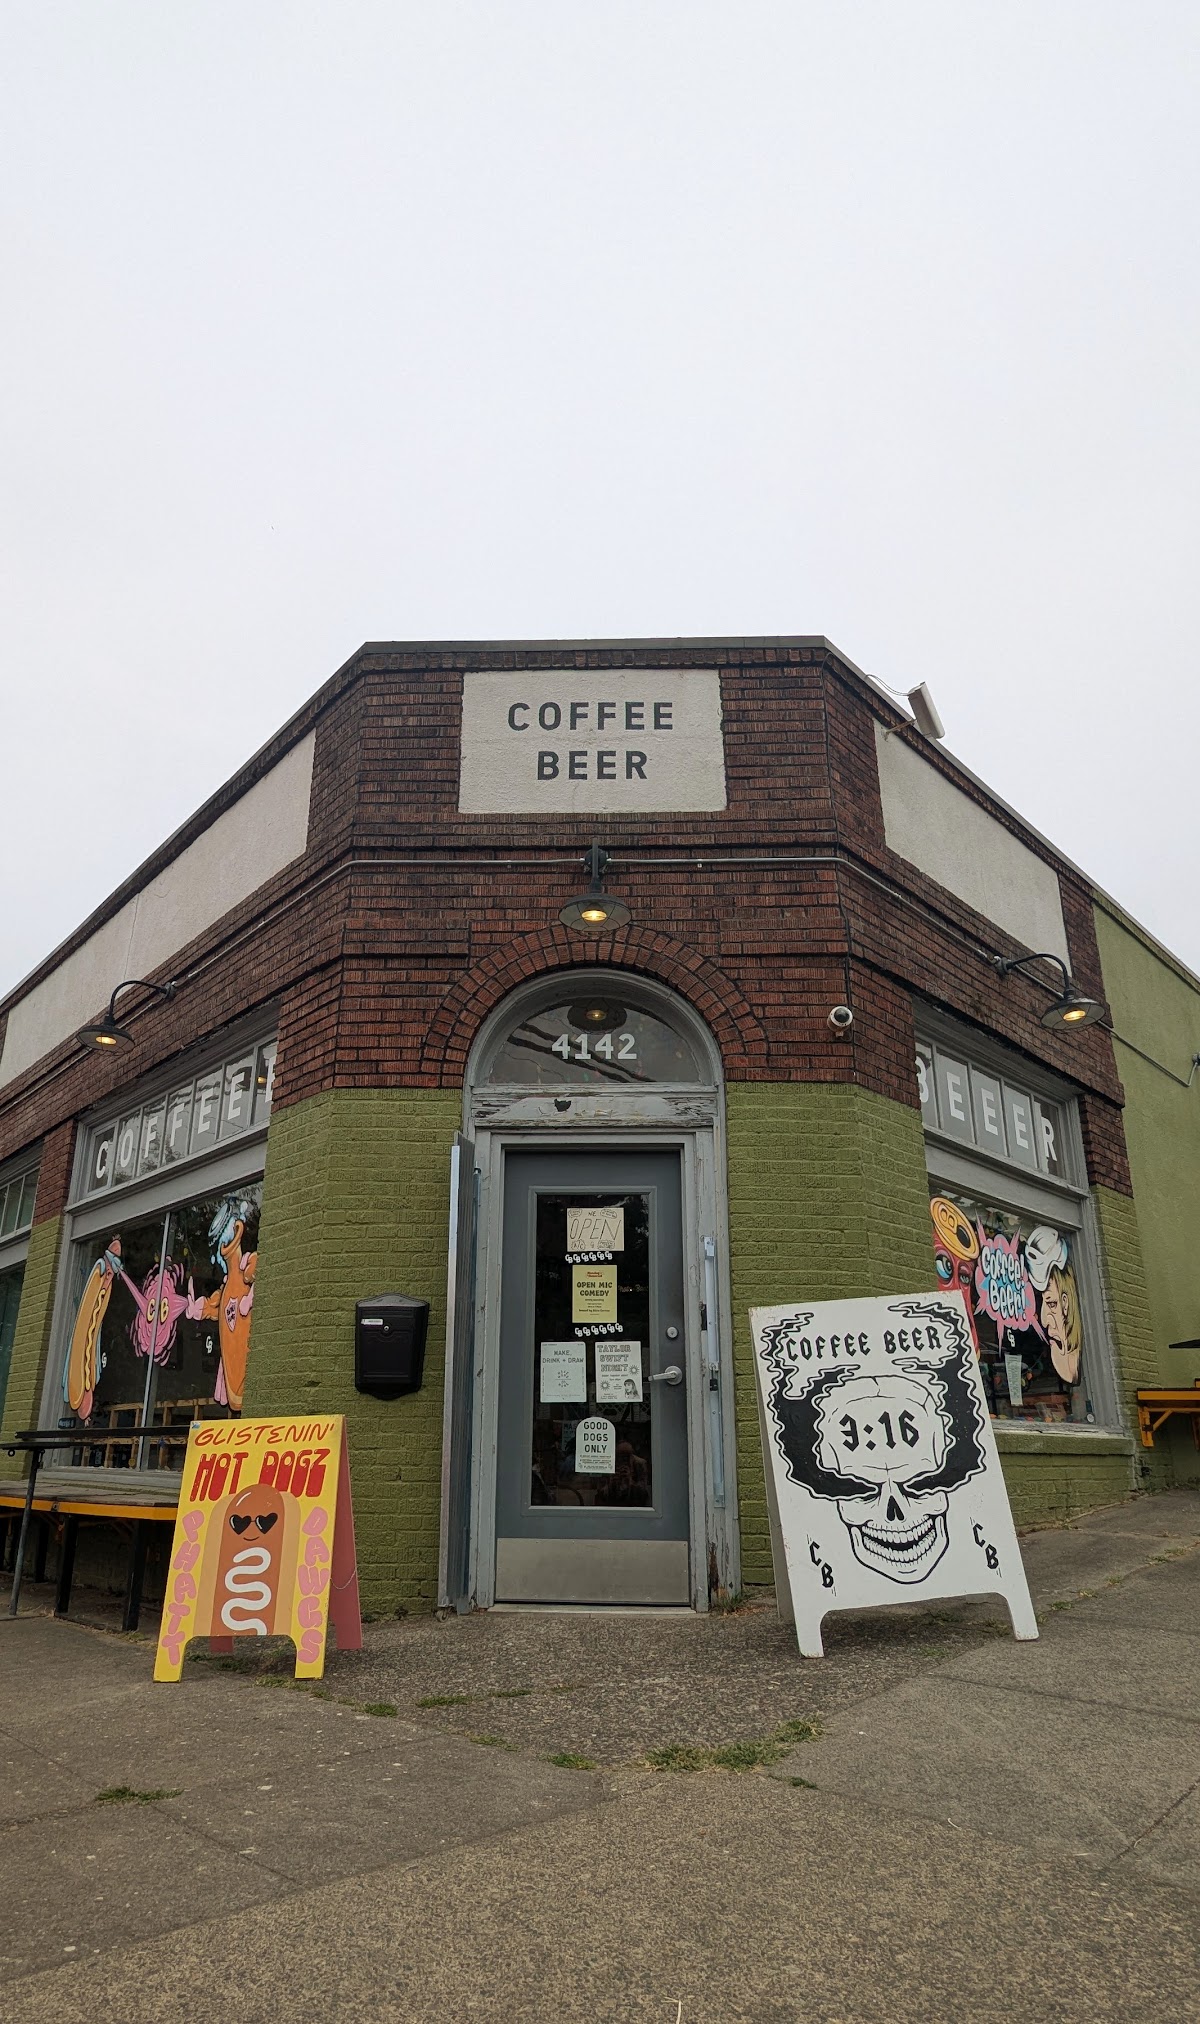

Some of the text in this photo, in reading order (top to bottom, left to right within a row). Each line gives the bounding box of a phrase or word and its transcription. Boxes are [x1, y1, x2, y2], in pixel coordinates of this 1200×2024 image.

[508, 701, 673, 731] COFFEE
[537, 750, 648, 780] BEER
[551, 1033, 637, 1060] 4142
[570, 1218, 621, 1241] OPEN
[982, 1246, 1025, 1290] Coffee!
[576, 1281, 596, 1289] OPEN
[598, 1281, 613, 1289] MIC
[579, 1289, 610, 1297] COMEDY
[990, 1279, 1026, 1321] Beer!
[597, 1344, 631, 1353] TAYLOR
[785, 1326, 942, 1362] COFFEE BEER
[600, 1354, 629, 1362] SWIFT
[194, 1423, 335, 1447] GLISTENIN'
[583, 1421, 608, 1430] GOOD
[583, 1433, 609, 1442] DOGS
[838, 1409, 920, 1452] 3:16
[584, 1444, 607, 1453] ONLY
[189, 1448, 331, 1502] HOT DOGZ
[161, 1509, 205, 1666] PHATT
[296, 1506, 330, 1664] DAWGS
